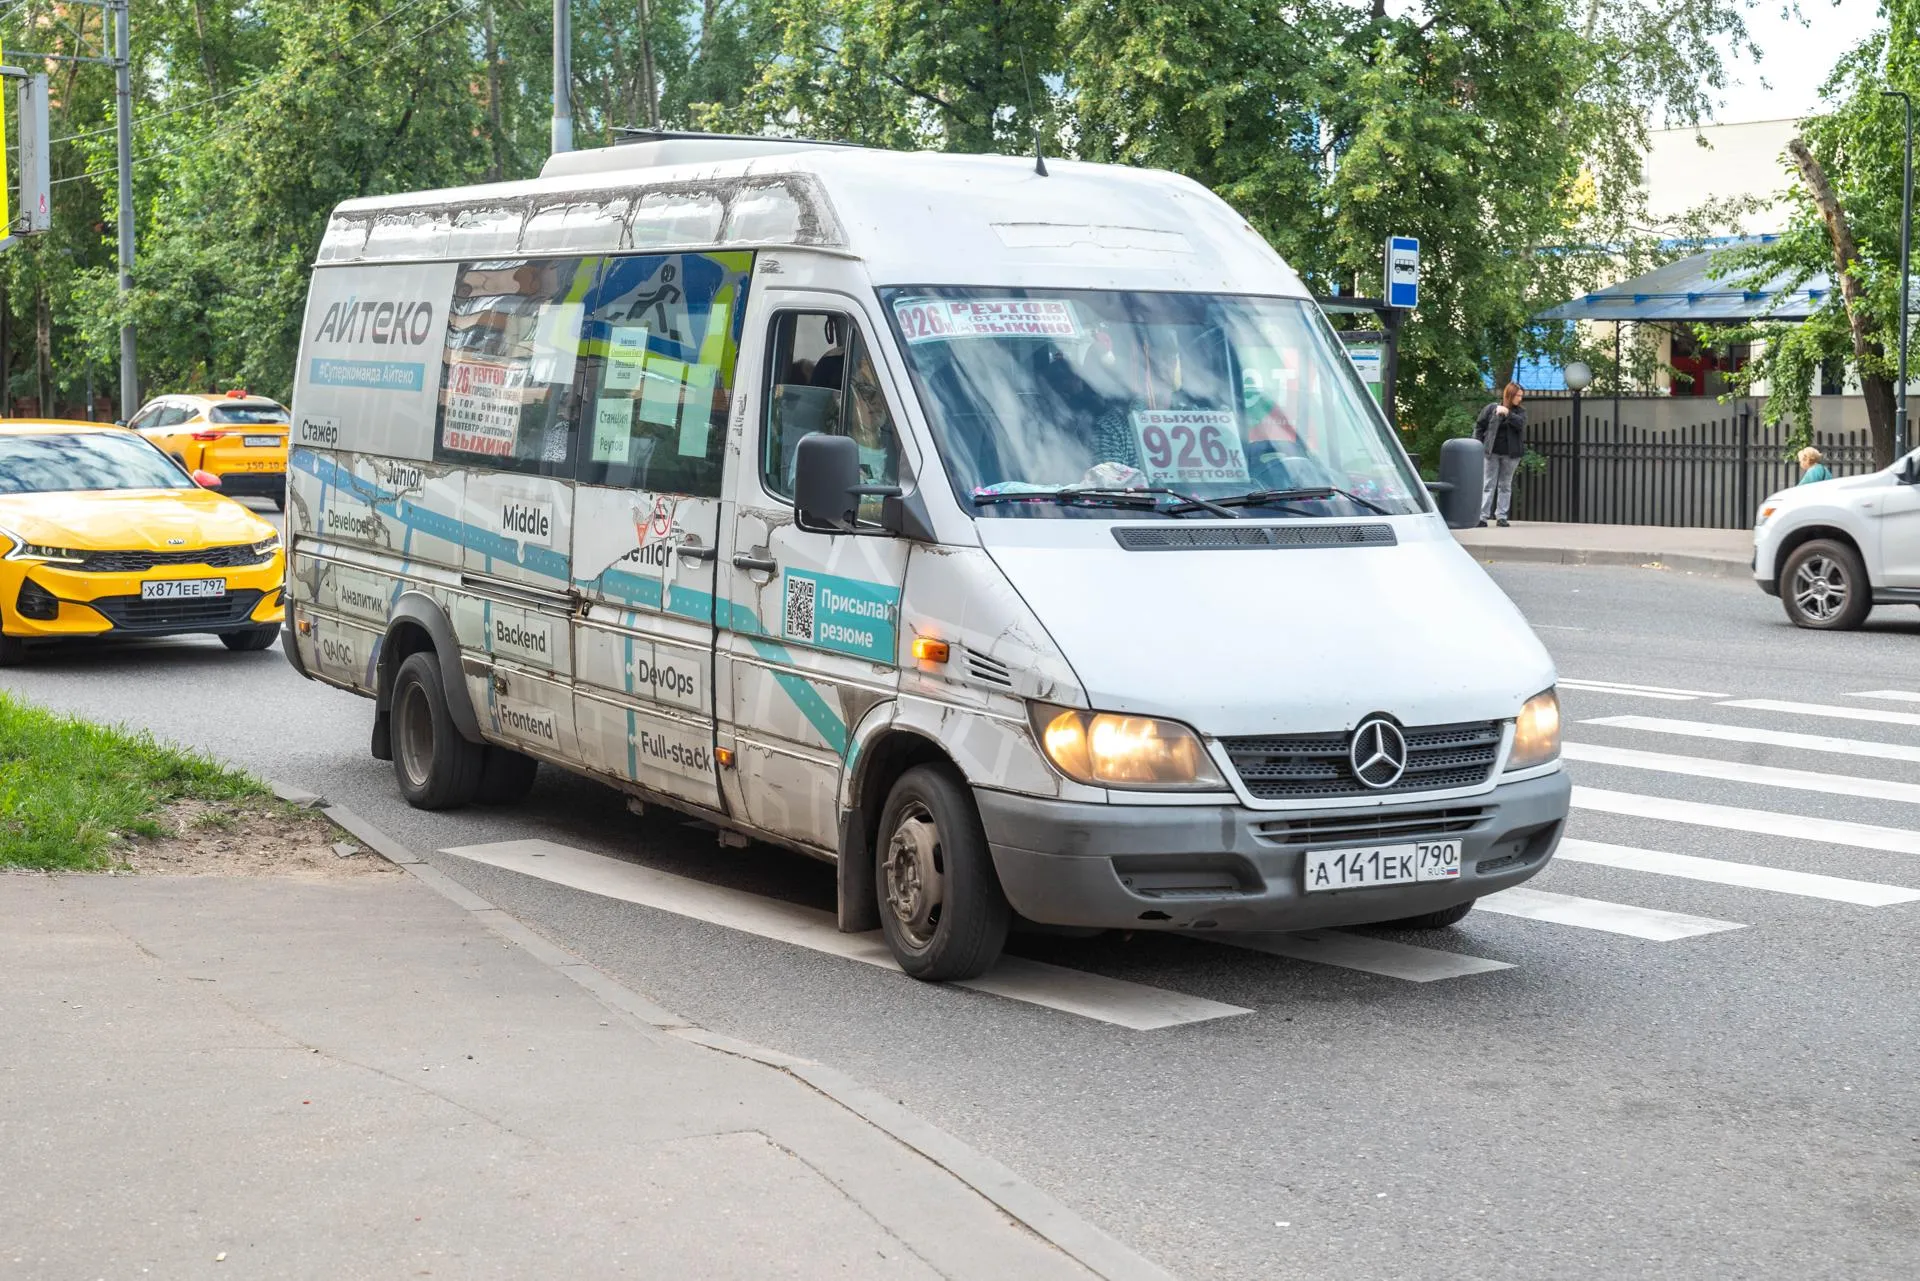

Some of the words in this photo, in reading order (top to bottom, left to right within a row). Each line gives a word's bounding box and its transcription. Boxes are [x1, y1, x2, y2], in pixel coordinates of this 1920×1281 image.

[950, 302, 1065, 315] РЕУТОВ
[974, 322, 1073, 334] ВЫХИНО
[318, 361, 381, 384] #Суперкоманда
[382, 365, 415, 385] Айтеко
[1151, 414, 1232, 424] ВЫХИНО
[301, 419, 338, 449] Стажёр
[599, 436, 624, 455] Реутов
[1177, 469, 1245, 479] РЕУТОВО
[502, 504, 549, 537] Middle
[147, 583, 200, 597] Х871ЕЕ
[202, 580, 222, 591] 797
[341, 585, 383, 613] Аналитик
[821, 588, 894, 620] Присылай
[496, 620, 546, 652] Backend
[820, 622, 874, 648] резюме
[323, 638, 352, 665] QA/QC
[639, 660, 694, 697] DevOps
[500, 704, 554, 740] Frontend
[641, 731, 713, 773] Full-stack
[1315, 851, 1413, 886] А141ЕК
[1418, 844, 1455, 868] 790
[1428, 867, 1446, 876] RUS
